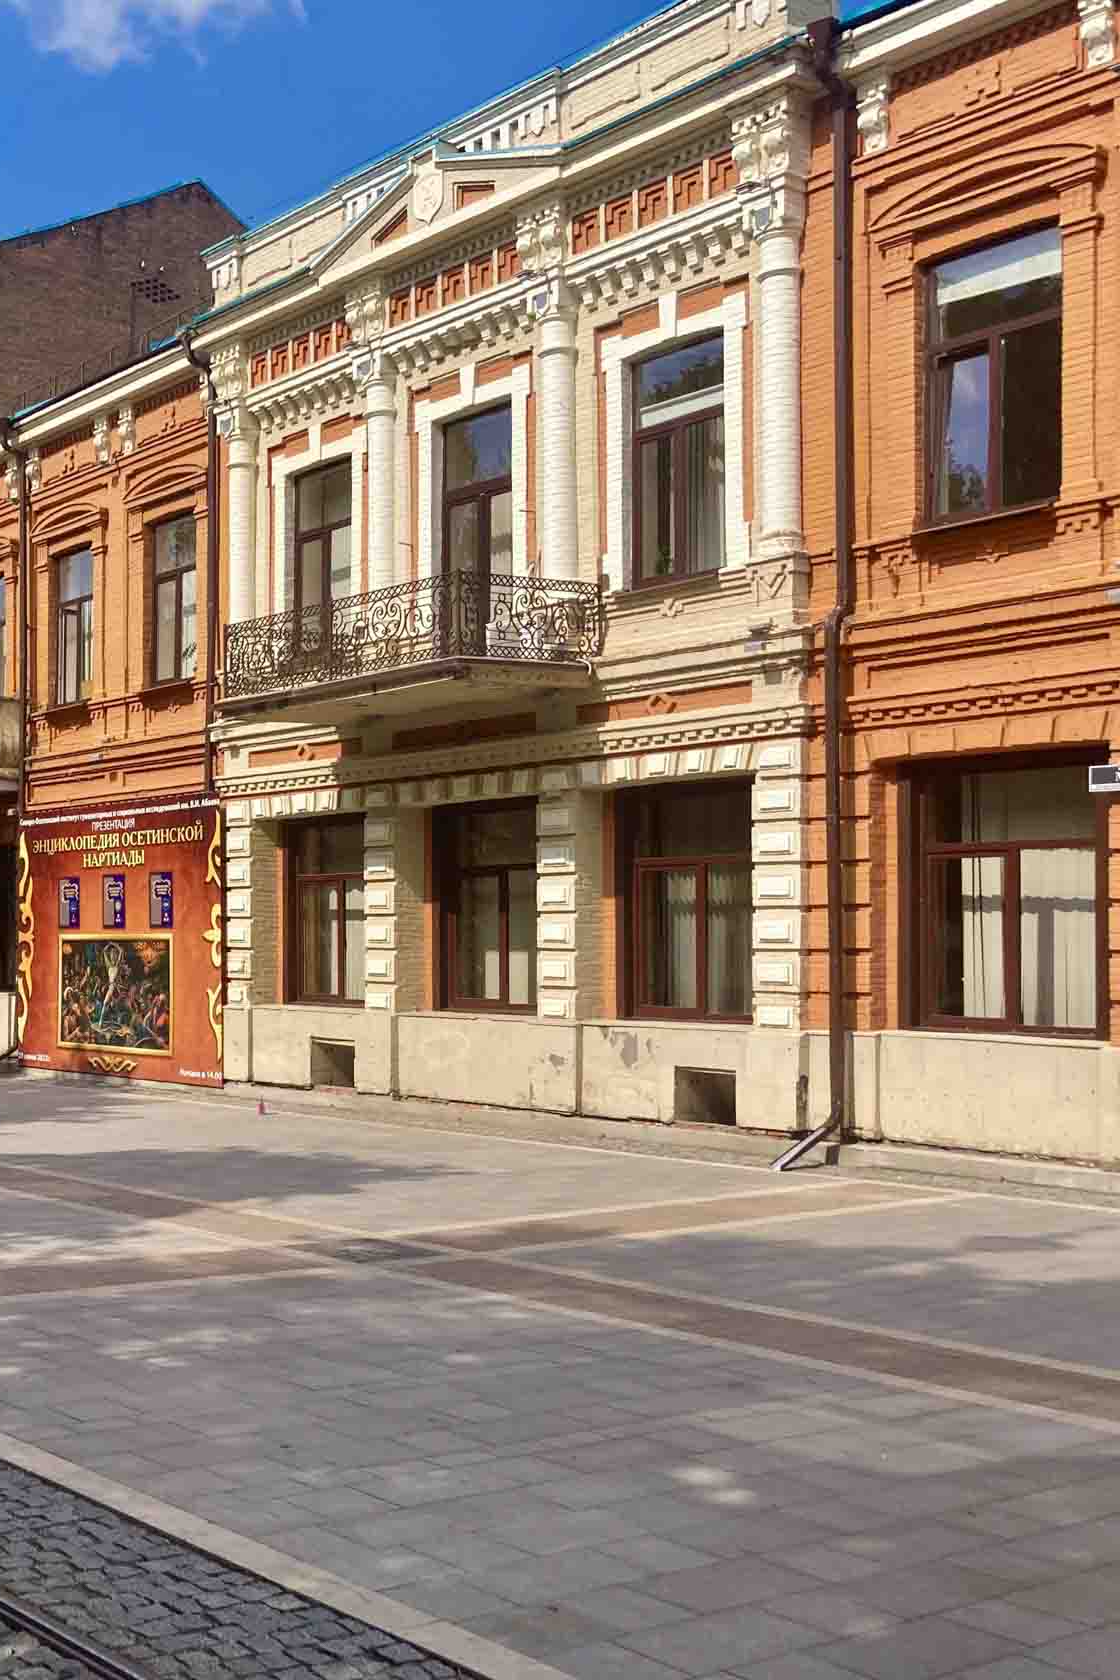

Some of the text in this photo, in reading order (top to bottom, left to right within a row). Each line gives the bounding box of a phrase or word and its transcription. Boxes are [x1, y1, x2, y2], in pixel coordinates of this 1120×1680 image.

[91, 817, 135, 832] ПРЕЗЕНТАЦИЯ
[32, 819, 203, 855] ЭНЦИКЛОПЕДИЯ ОСЕТИНСКОЙ
[83, 849, 145, 868] НАРТИАДЫ
